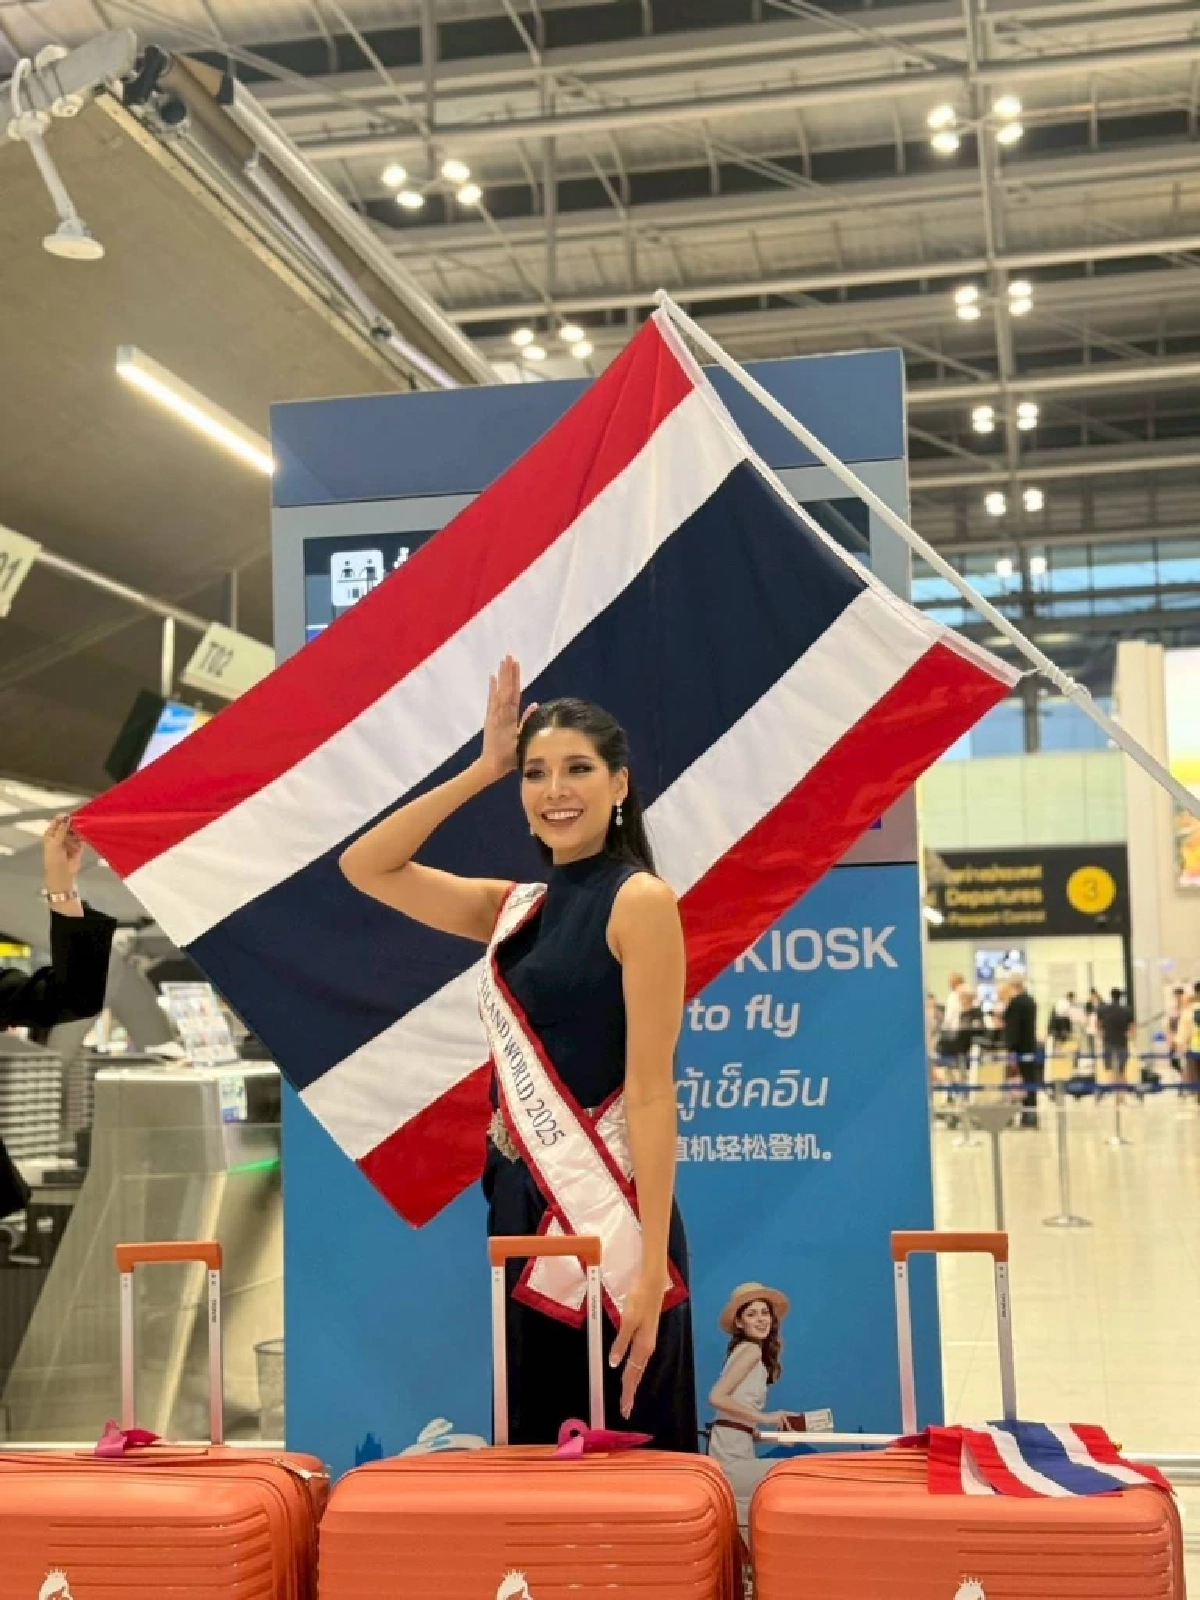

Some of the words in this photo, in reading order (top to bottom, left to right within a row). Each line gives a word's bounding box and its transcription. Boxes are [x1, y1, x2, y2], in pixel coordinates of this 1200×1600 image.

[198, 641, 234, 678] T02
[1083, 878, 1099, 903] 3
[733, 925, 899, 973] KIOSK
[687, 997, 731, 1032] to
[744, 993, 801, 1038] fly
[503, 1034, 535, 1102] WORLD
[525, 1098, 566, 1147] 2025
